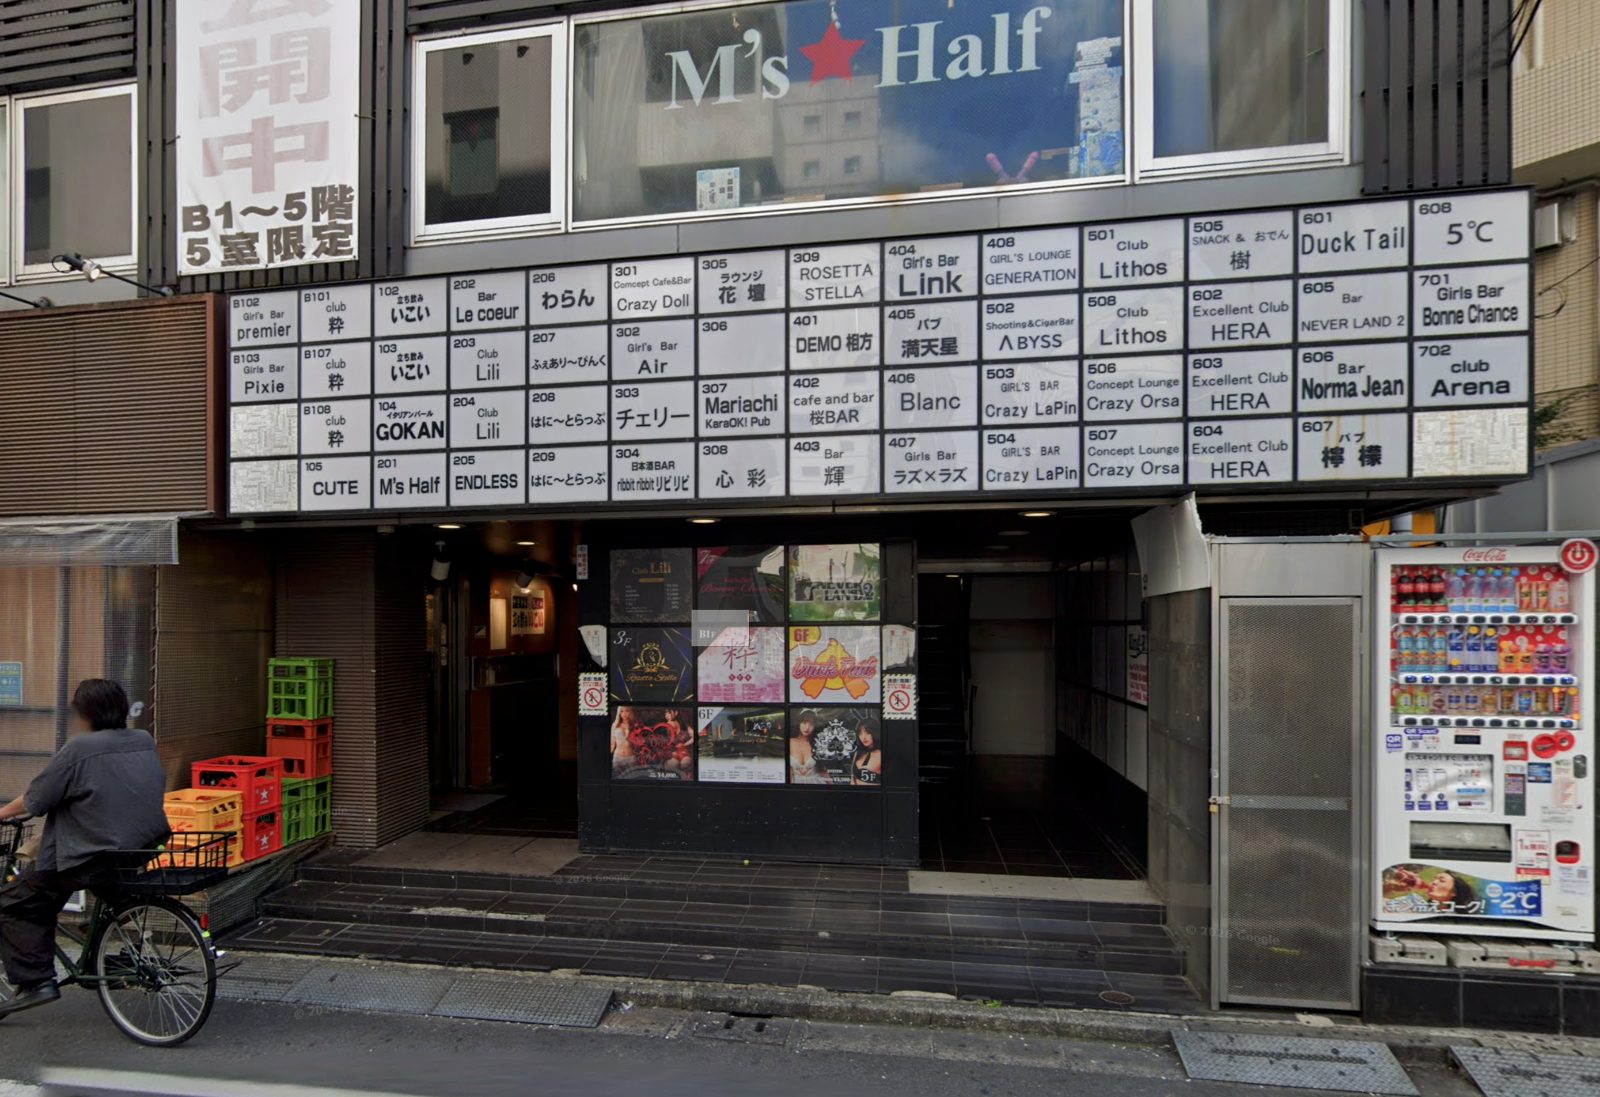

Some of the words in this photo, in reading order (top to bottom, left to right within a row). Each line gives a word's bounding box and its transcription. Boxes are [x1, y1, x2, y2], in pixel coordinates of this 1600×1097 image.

[873, 6, 1051, 89] Half
[1419, 202, 1452, 215] 608
[1303, 212, 1332, 224] 601
[1194, 220, 1224, 233] 505
[1088, 229, 1114, 241] 501
[1193, 234, 1230, 246] SNACK
[1235, 233, 1245, 243] &
[1254, 230, 1289, 242] おでん
[1301, 231, 1356, 255] Duck
[1363, 227, 1405, 250] Tail
[185, 221, 354, 268] 5室限定
[987, 237, 1015, 248] 408
[1116, 240, 1149, 251] Club
[889, 245, 916, 256] 404
[1029, 249, 1071, 261] LOUNGE
[793, 252, 820, 263] 309
[702, 258, 727, 270] 305
[1100, 260, 1167, 279] Lithos
[533, 272, 555, 283] 206
[615, 266, 637, 277] 301
[720, 270, 763, 284] ラウンジ
[800, 263, 873, 280] ROSETTA
[985, 268, 1076, 286] GENERATION
[453, 279, 476, 290] 202
[652, 276, 692, 286] Cafe&Bar
[899, 271, 962, 297] Link
[1419, 274, 1449, 286] 701
[379, 286, 399, 296] 102
[804, 285, 864, 301] STELLA
[1303, 281, 1334, 294] 605
[304, 291, 330, 302] B101
[478, 292, 497, 302] Bar
[542, 288, 595, 310] わらん
[1193, 289, 1223, 301] 602
[233, 297, 260, 308] B102
[325, 301, 347, 313] club
[617, 298, 657, 312] Crazy
[663, 294, 689, 308] Doll
[986, 303, 1014, 314] 502
[391, 306, 430, 324] いこい
[456, 307, 473, 323] Le
[477, 306, 519, 322] coeur
[888, 309, 915, 320] 405
[1193, 304, 1254, 317] Excellent
[1259, 301, 1289, 314] Club
[243, 311, 264, 321] Girl's
[270, 310, 284, 319] Bar
[793, 315, 817, 326] 401
[1423, 307, 1464, 327] Bonne
[1468, 304, 1518, 324] Chance
[702, 321, 727, 332] 306
[1301, 318, 1348, 331] NEVER
[1353, 316, 1392, 329] LAND
[1397, 315, 1405, 326] 2
[237, 322, 291, 341] premier
[532, 332, 555, 343] 207
[616, 327, 640, 337] 302
[1212, 322, 1271, 341] HERA
[454, 338, 476, 348] 203
[796, 335, 842, 353] DEMO
[1418, 344, 1451, 357] 702
[233, 353, 260, 364] B103
[1302, 351, 1334, 363] 606
[243, 366, 264, 374] Girls
[269, 364, 284, 373] Bar
[476, 363, 499, 381] Lili
[638, 359, 668, 374] Air
[1088, 363, 1116, 374] 506
[888, 373, 915, 384] 406
[987, 368, 1015, 379] 503
[245, 380, 285, 394] Pixie
[702, 383, 727, 394] 307
[793, 378, 819, 388] 402
[1040, 380, 1059, 391] BAR
[1087, 380, 1134, 390] Concept
[1138, 378, 1180, 388] Lounge
[1301, 378, 1358, 400] Norma
[1361, 375, 1404, 397] Jean
[1431, 379, 1510, 397] Arena
[532, 392, 555, 403] 208
[615, 388, 639, 398] 303
[793, 394, 821, 406] cafe
[825, 393, 849, 405] and
[853, 392, 874, 403] bar
[378, 401, 397, 411] 104
[705, 394, 778, 414] Mariachi
[900, 392, 961, 412] Blanc
[1087, 396, 1134, 412] Crazy
[1140, 394, 1180, 408] Orsa
[304, 405, 331, 415] B108
[985, 404, 1028, 418] Crazy
[1035, 401, 1077, 416] LaPin
[616, 407, 690, 430] チェリー
[750, 416, 771, 427] Pub
[809, 409, 859, 425] 桜BAR
[376, 420, 444, 441] GOKAN
[1302, 421, 1333, 432] 607
[793, 441, 820, 452] 403
[888, 437, 916, 448] 407
[616, 448, 640, 459] 304
[703, 445, 728, 455] 308
[377, 459, 396, 468] 201
[453, 455, 475, 465] 205
[632, 461, 675, 471] 日本酒BAR
[305, 462, 323, 471] 105
[455, 473, 518, 490] ENDLESS
[824, 466, 845, 486] 輝
[313, 480, 358, 496] CUTE
[380, 477, 404, 495] M's
[409, 476, 440, 494] Half
[698, 709, 714, 720] 6F
[861, 770, 877, 782] 5F
